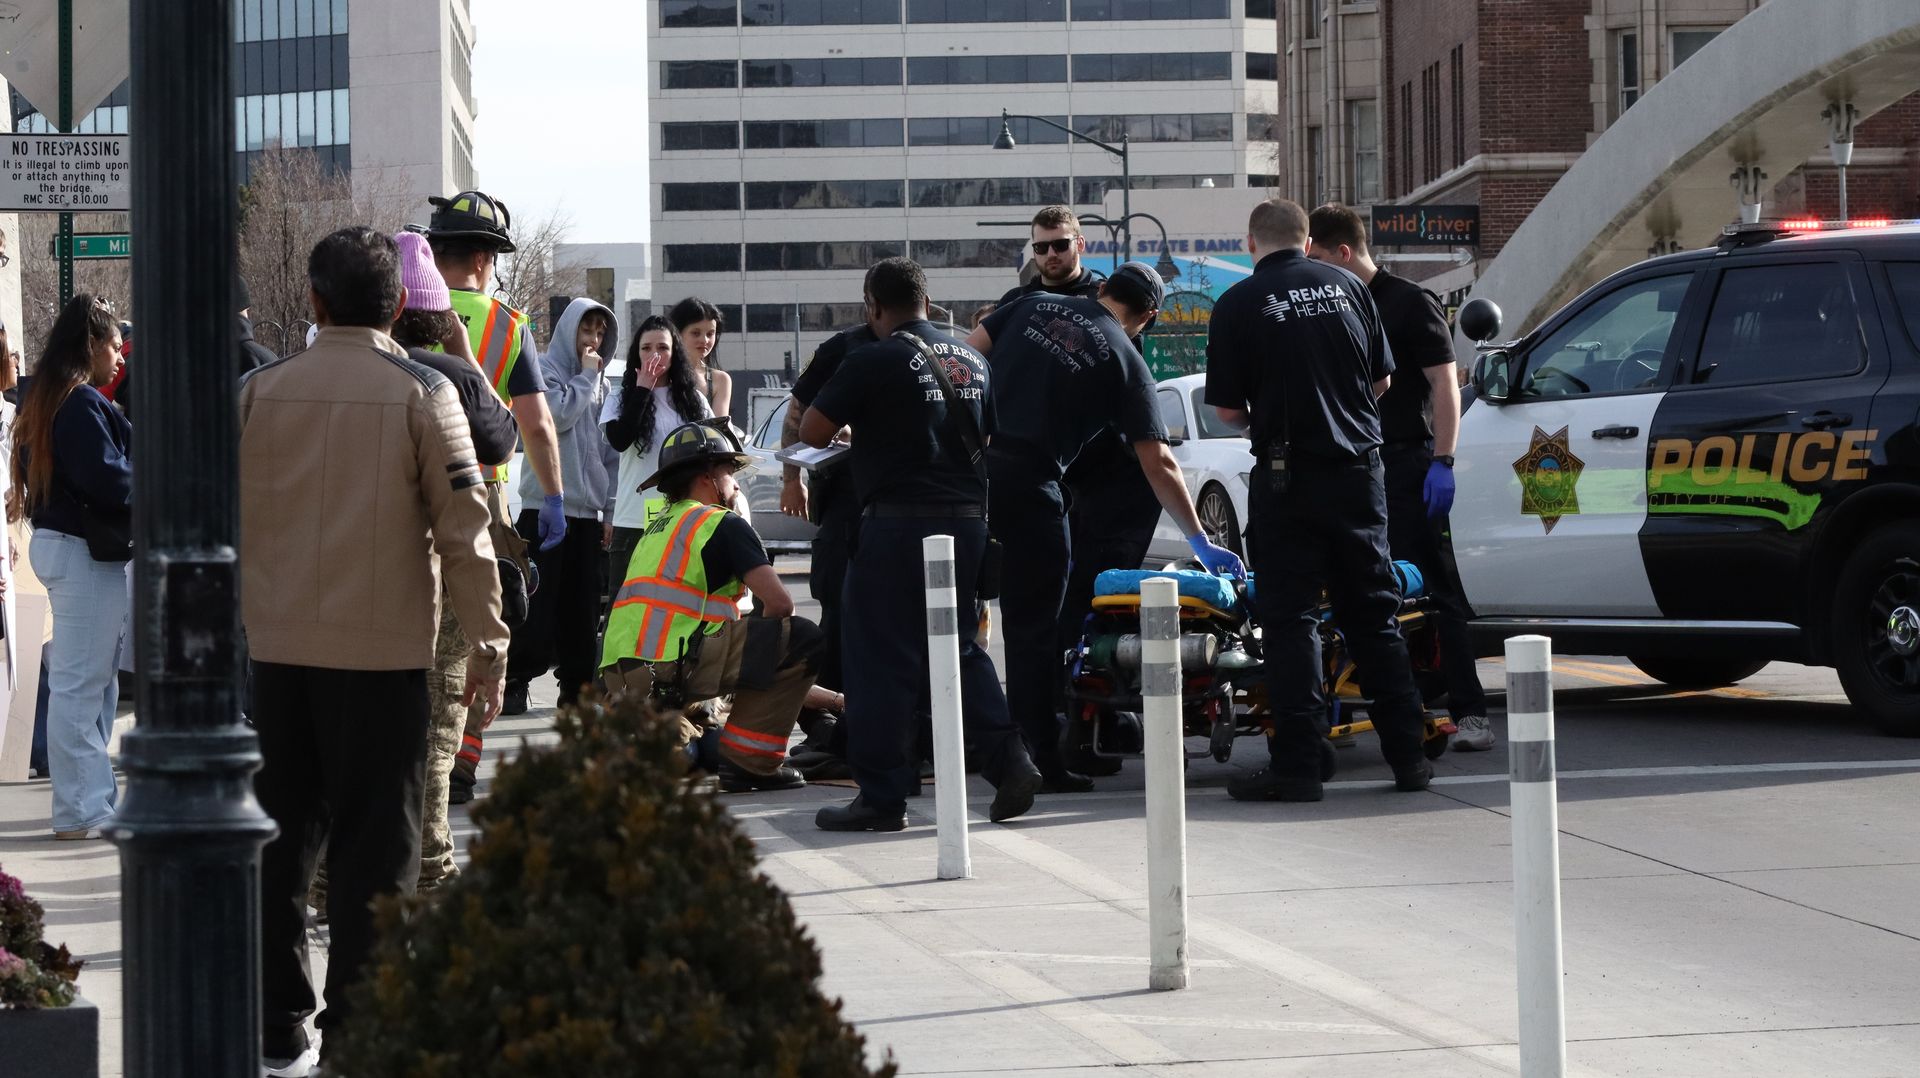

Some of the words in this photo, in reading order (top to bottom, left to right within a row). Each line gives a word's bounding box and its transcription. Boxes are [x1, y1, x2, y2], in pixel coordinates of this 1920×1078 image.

[12, 141, 29, 156] NO
[36, 141, 120, 156] TRESPASSING
[3, 160, 10, 169] It
[15, 160, 22, 169] is
[27, 160, 56, 171] illegal
[61, 161, 70, 169] to
[75, 160, 101, 169] climb
[105, 162, 129, 171] upon
[26, 172, 58, 181] attach
[62, 172, 106, 183] anything
[110, 172, 120, 181] to
[39, 184, 55, 193] the
[60, 184, 93, 195] bridge.
[23, 194, 43, 204] RMC
[72, 194, 109, 204] 8.10.010
[1376, 215, 1417, 233] wild
[1427, 215, 1474, 232] river
[110, 239, 130, 253] Mil
[1137, 239, 1189, 252] STATE
[1194, 238, 1243, 252] BANK
[1288, 284, 1347, 303] REMSA
[1293, 298, 1352, 318] HEALTH
[1023, 326, 1053, 349] FIRE
[1035, 302, 1074, 317] CITY
[1072, 313, 1093, 327] OF
[1086, 325, 1110, 361] RENO
[909, 351, 927, 371] CIT
[933, 342, 949, 355] OF
[950, 344, 984, 370] RENO
[924, 389, 944, 402] FIR
[1650, 429, 1879, 489] POLICE
[1649, 493, 1694, 507] CITY
